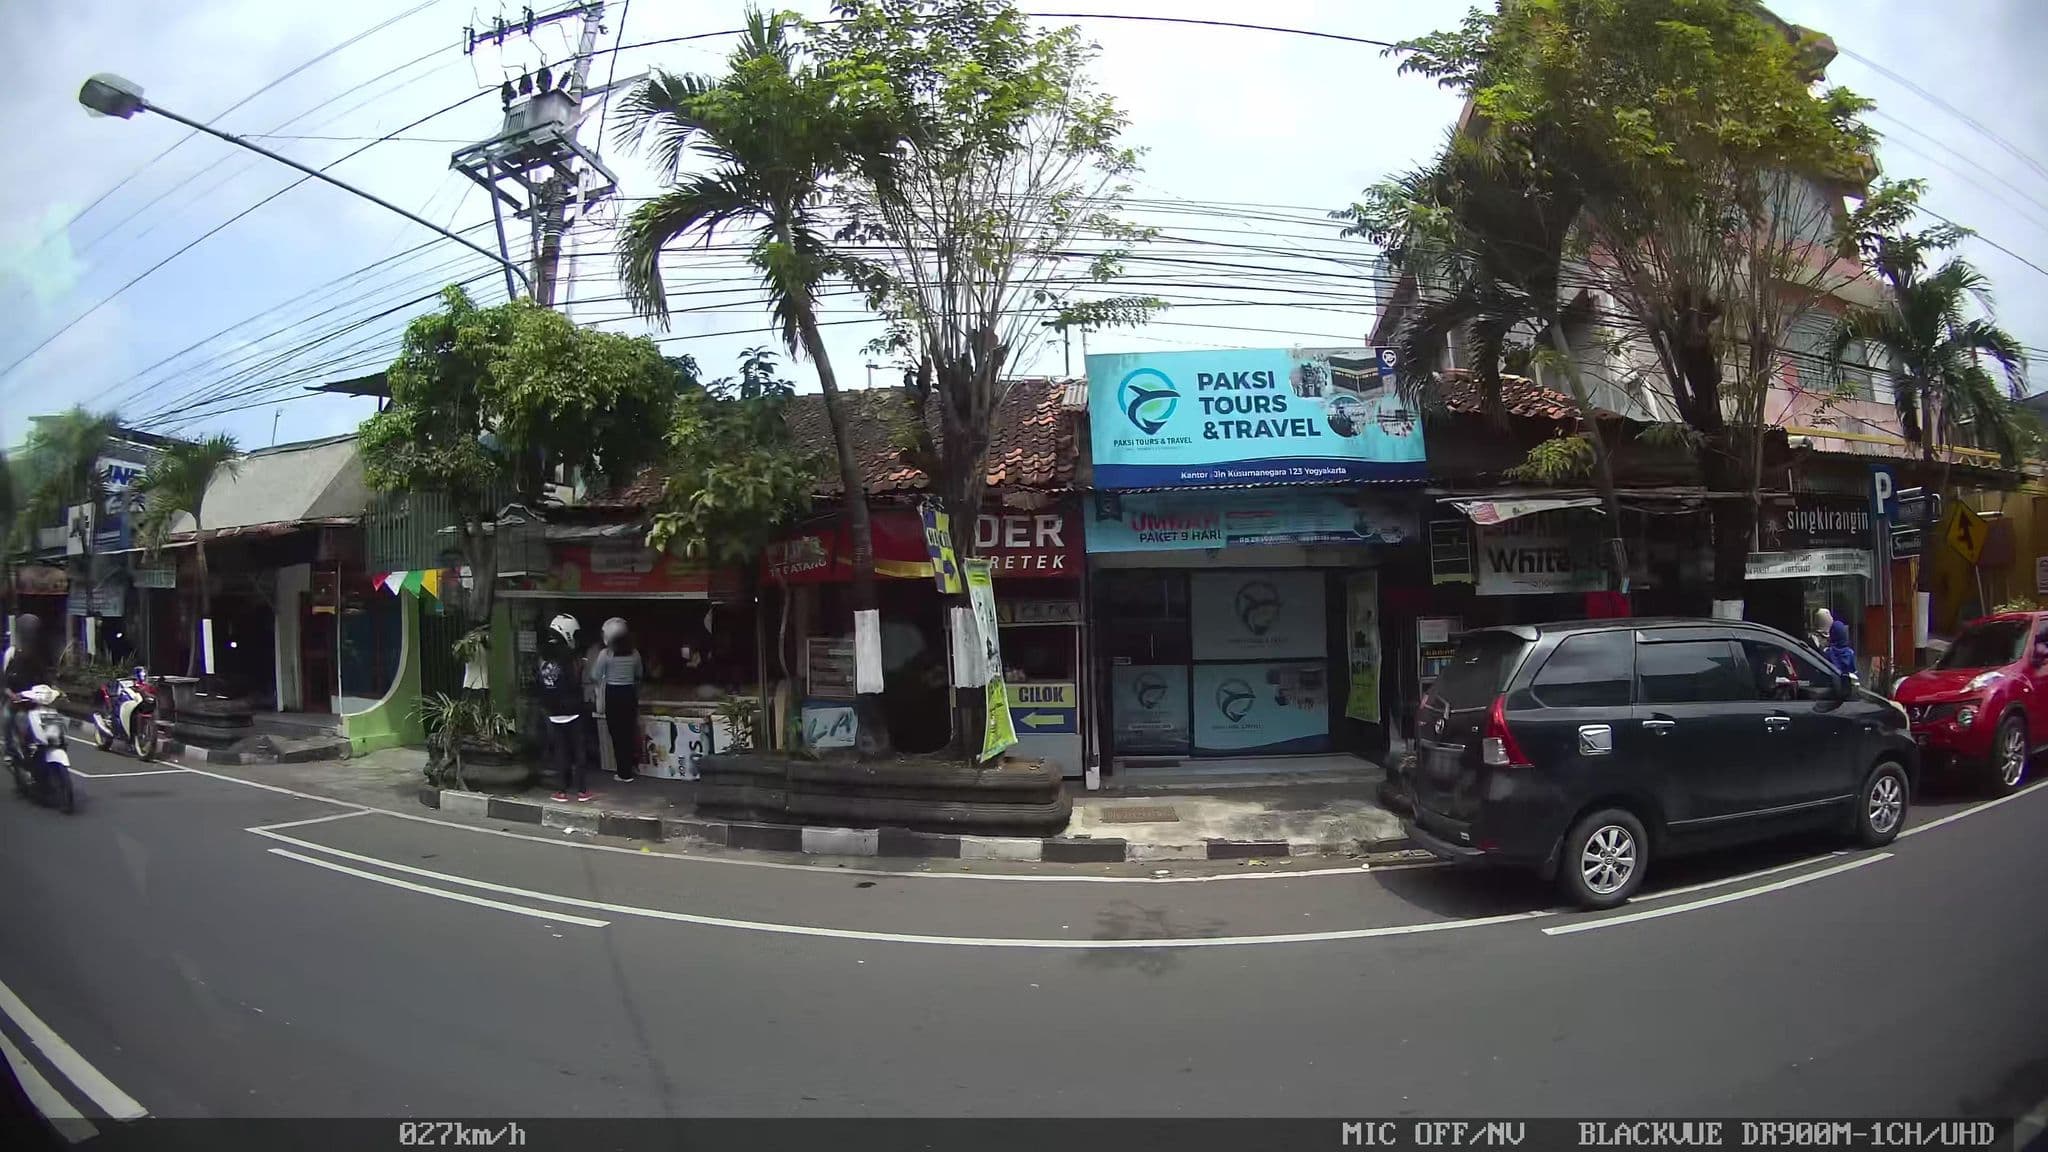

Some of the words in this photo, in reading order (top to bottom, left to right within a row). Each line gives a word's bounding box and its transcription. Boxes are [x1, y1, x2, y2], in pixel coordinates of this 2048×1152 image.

[1198, 371, 1275, 390] PAKSI
[1199, 395, 1288, 415] TOURS
[1203, 418, 1322, 440] &TRAVEL
[1113, 439, 1134, 447] PAKSI
[1136, 437, 1159, 446] TOURS
[1181, 471, 1208, 479] Kantor
[1228, 469, 1287, 478] Kusumanegara
[1289, 467, 1303, 475] 123
[1305, 466, 1347, 476] Yogyakarta
[1875, 471, 1892, 514] P
[1787, 506, 1869, 534] singkirangin
[1139, 532, 1178, 542] PAKET
[1181, 531, 1188, 541] 9
[1019, 687, 1065, 703] CILOK
